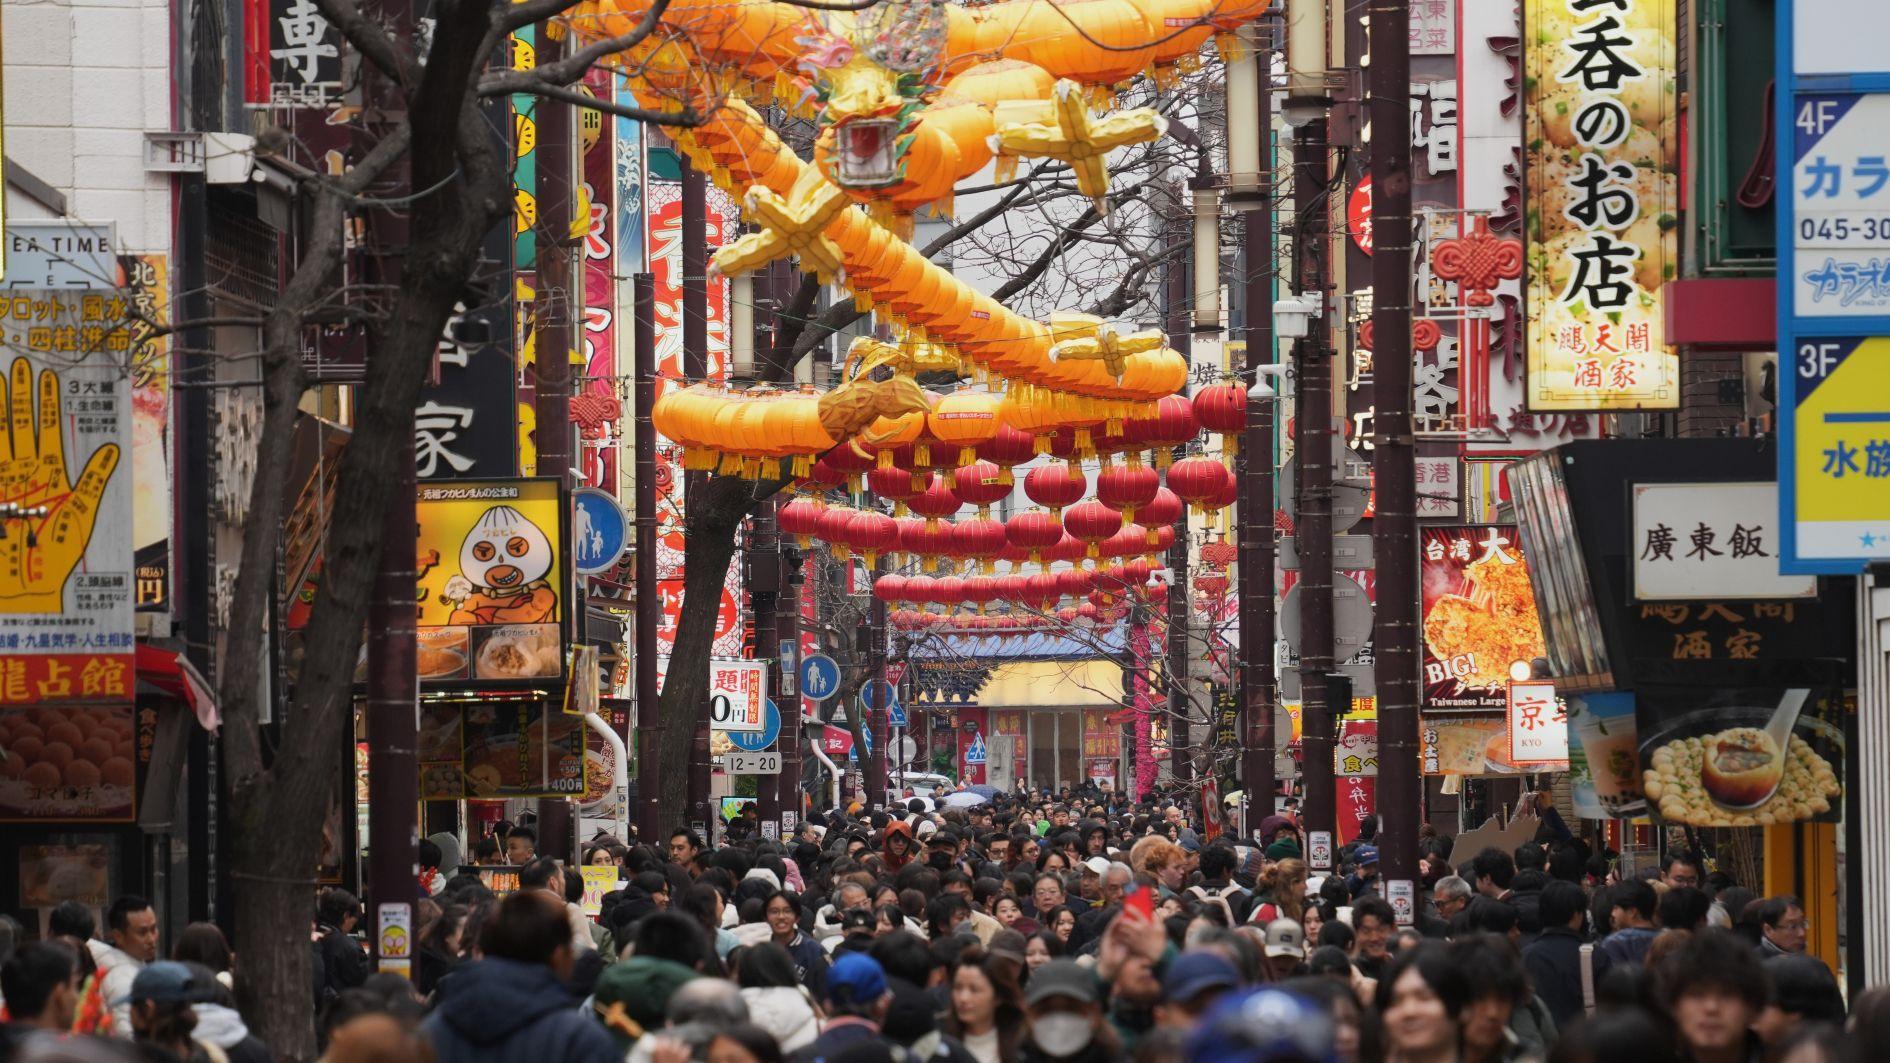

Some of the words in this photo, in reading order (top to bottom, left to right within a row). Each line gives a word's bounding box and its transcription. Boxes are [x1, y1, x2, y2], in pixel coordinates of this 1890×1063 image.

[1796, 101, 1838, 135] 4F
[1561, 0, 1642, 310] 呑のお店
[1802, 156, 1890, 198] カラ
[1801, 218, 1890, 240] 045-30
[7, 237, 39, 252] EA
[51, 237, 108, 252] TIME
[1574, 358, 1637, 388] 酒家
[1799, 344, 1840, 378] 3F
[1641, 522, 1778, 562] 廣東飯
[136, 566, 164, 577] (税込)
[137, 578, 162, 606] 円
[1673, 628, 1763, 659] 酒家
[1425, 652, 1479, 685] BIG!
[1430, 698, 1477, 707] Taiwanese
[1480, 697, 1506, 707] Large
[1454, 680, 1506, 697] ダーチ
[1521, 738, 1542, 747] KYO
